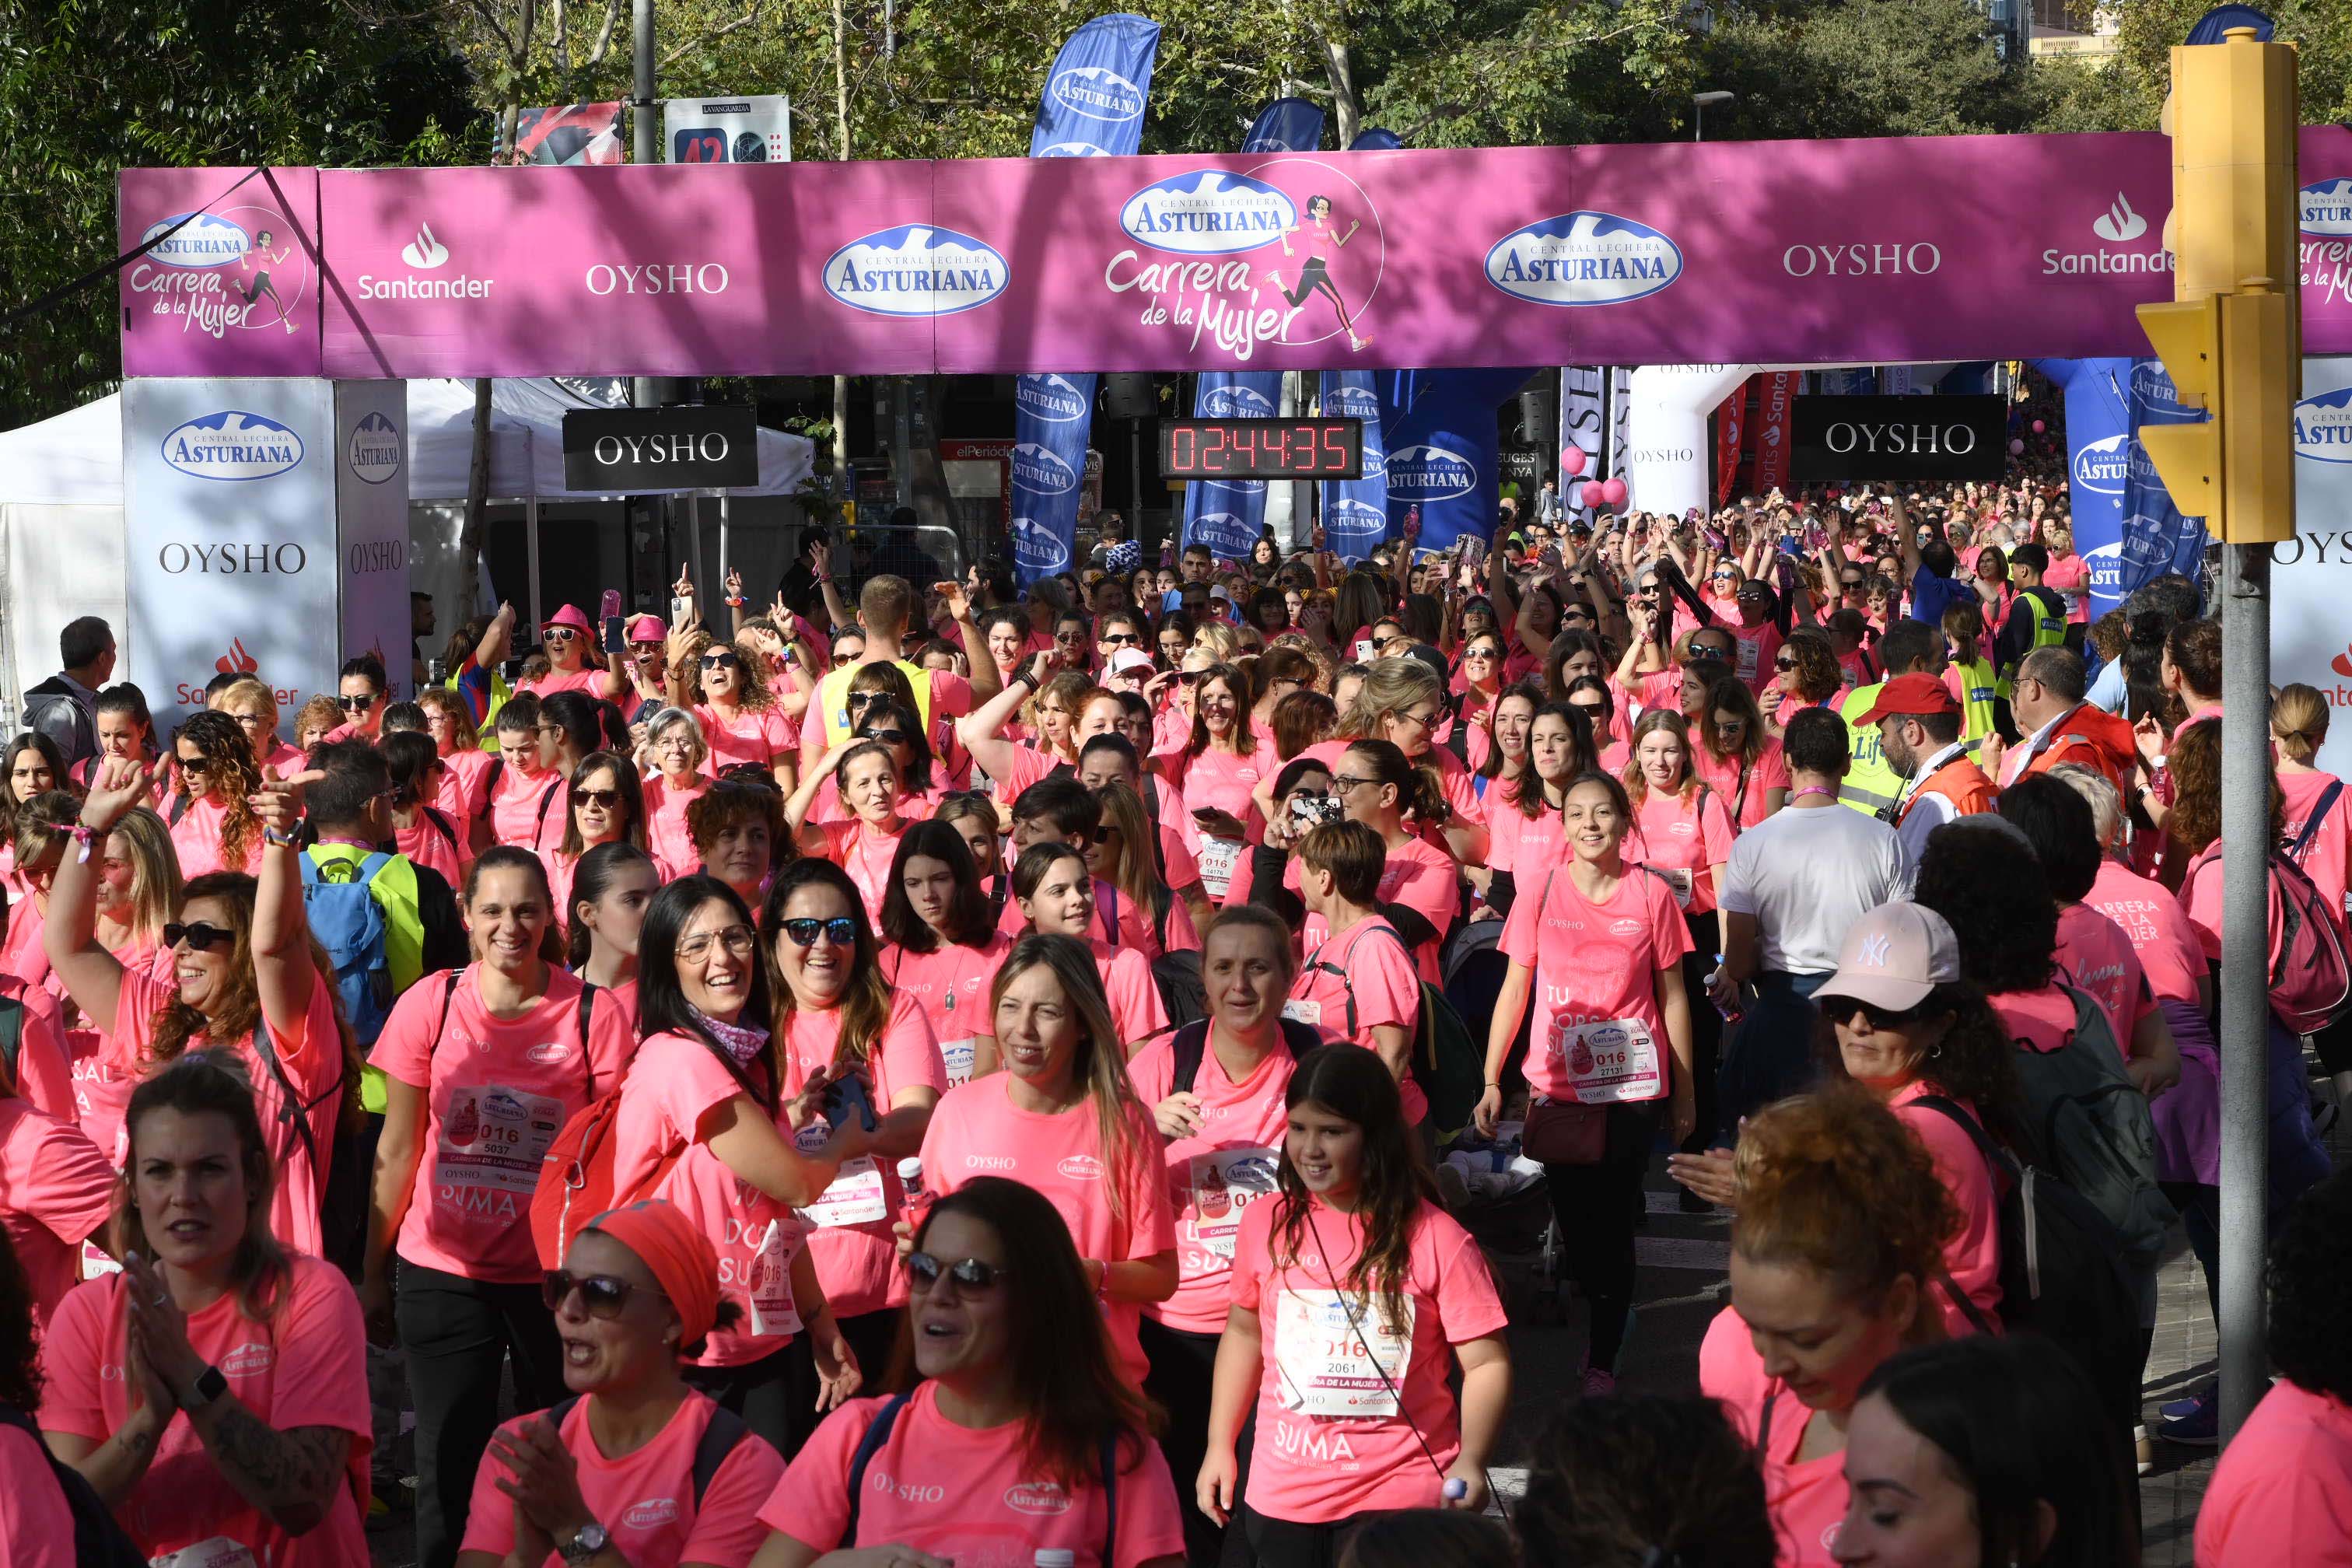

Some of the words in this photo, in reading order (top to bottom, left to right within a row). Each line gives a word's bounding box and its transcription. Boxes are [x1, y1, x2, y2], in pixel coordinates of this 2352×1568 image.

[1058, 78, 1136, 114] ASTURIANA
[1160, 199, 1215, 208] CENTRAL
[1133, 201, 1283, 233] ASTURIANA
[149, 232, 242, 254] ASTURIANA
[1530, 244, 1591, 254] CENTRAL
[1598, 243, 1661, 254] LECHERA
[866, 256, 926, 265] CENTRAL
[930, 254, 989, 264] LECHERA
[1499, 247, 1668, 282] ASTURIANA
[1783, 242, 1941, 277] OYSHO
[131, 264, 222, 292] Carrera
[586, 263, 729, 296] OYSHO
[837, 258, 996, 292] ASTURIANA
[1105, 250, 1251, 293] Carrera
[2315, 264, 2328, 285] la
[358, 274, 494, 299] Santander
[153, 294, 170, 314] de
[173, 294, 186, 314] la
[184, 290, 257, 339] Mujer
[1140, 296, 1167, 325] de
[1174, 296, 1193, 325] la
[1188, 288, 1305, 361] Mujer
[2134, 372, 2178, 401] ASTUR
[1016, 380, 1078, 415] ASTURIANA
[1209, 397, 1274, 418] ASTURIAN
[1825, 422, 1976, 454] OYSHO
[173, 437, 293, 464] ASTURIANA
[353, 439, 398, 467] ASTURIANA
[594, 432, 729, 465] OYSHO
[1173, 428, 1345, 469] 02:44:35
[1634, 448, 1693, 463] OYSHO
[1084, 460, 1098, 471] VIS
[2080, 457, 2127, 479] ASTU
[1329, 516, 1381, 528] STURIANA
[159, 543, 306, 575] OYSHO
[350, 540, 402, 575] OYSHO
[1521, 835, 1549, 843] OYSHO
[1206, 858, 1227, 868] 016
[1548, 918, 1584, 930] OYSHO
[2128, 913, 2152, 926] LA
[1308, 928, 1328, 947] TU
[1547, 985, 1569, 1005] TU
[1592, 1035, 1625, 1044] ASTURIANA
[530, 1051, 568, 1059] ASTURIANA
[1596, 1052, 1626, 1066] 016
[1601, 1066, 1623, 1076] 27131
[481, 1125, 520, 1143] 016
[485, 1144, 510, 1155] 5037
[966, 1154, 1017, 1171] OYSHO
[446, 1170, 480, 1179] OYSHO
[840, 1206, 875, 1215] Santander
[1185, 1251, 1229, 1271] SU
[765, 1265, 781, 1281] 016
[1328, 1363, 1356, 1374] 2061
[1327, 1378, 1338, 1387] DE
[1351, 1380, 1377, 1388] MUJER
[1274, 1419, 1356, 1461] SUMA
[873, 1472, 944, 1503] OYSHO
[1010, 1491, 1068, 1509] ASTURIANA
